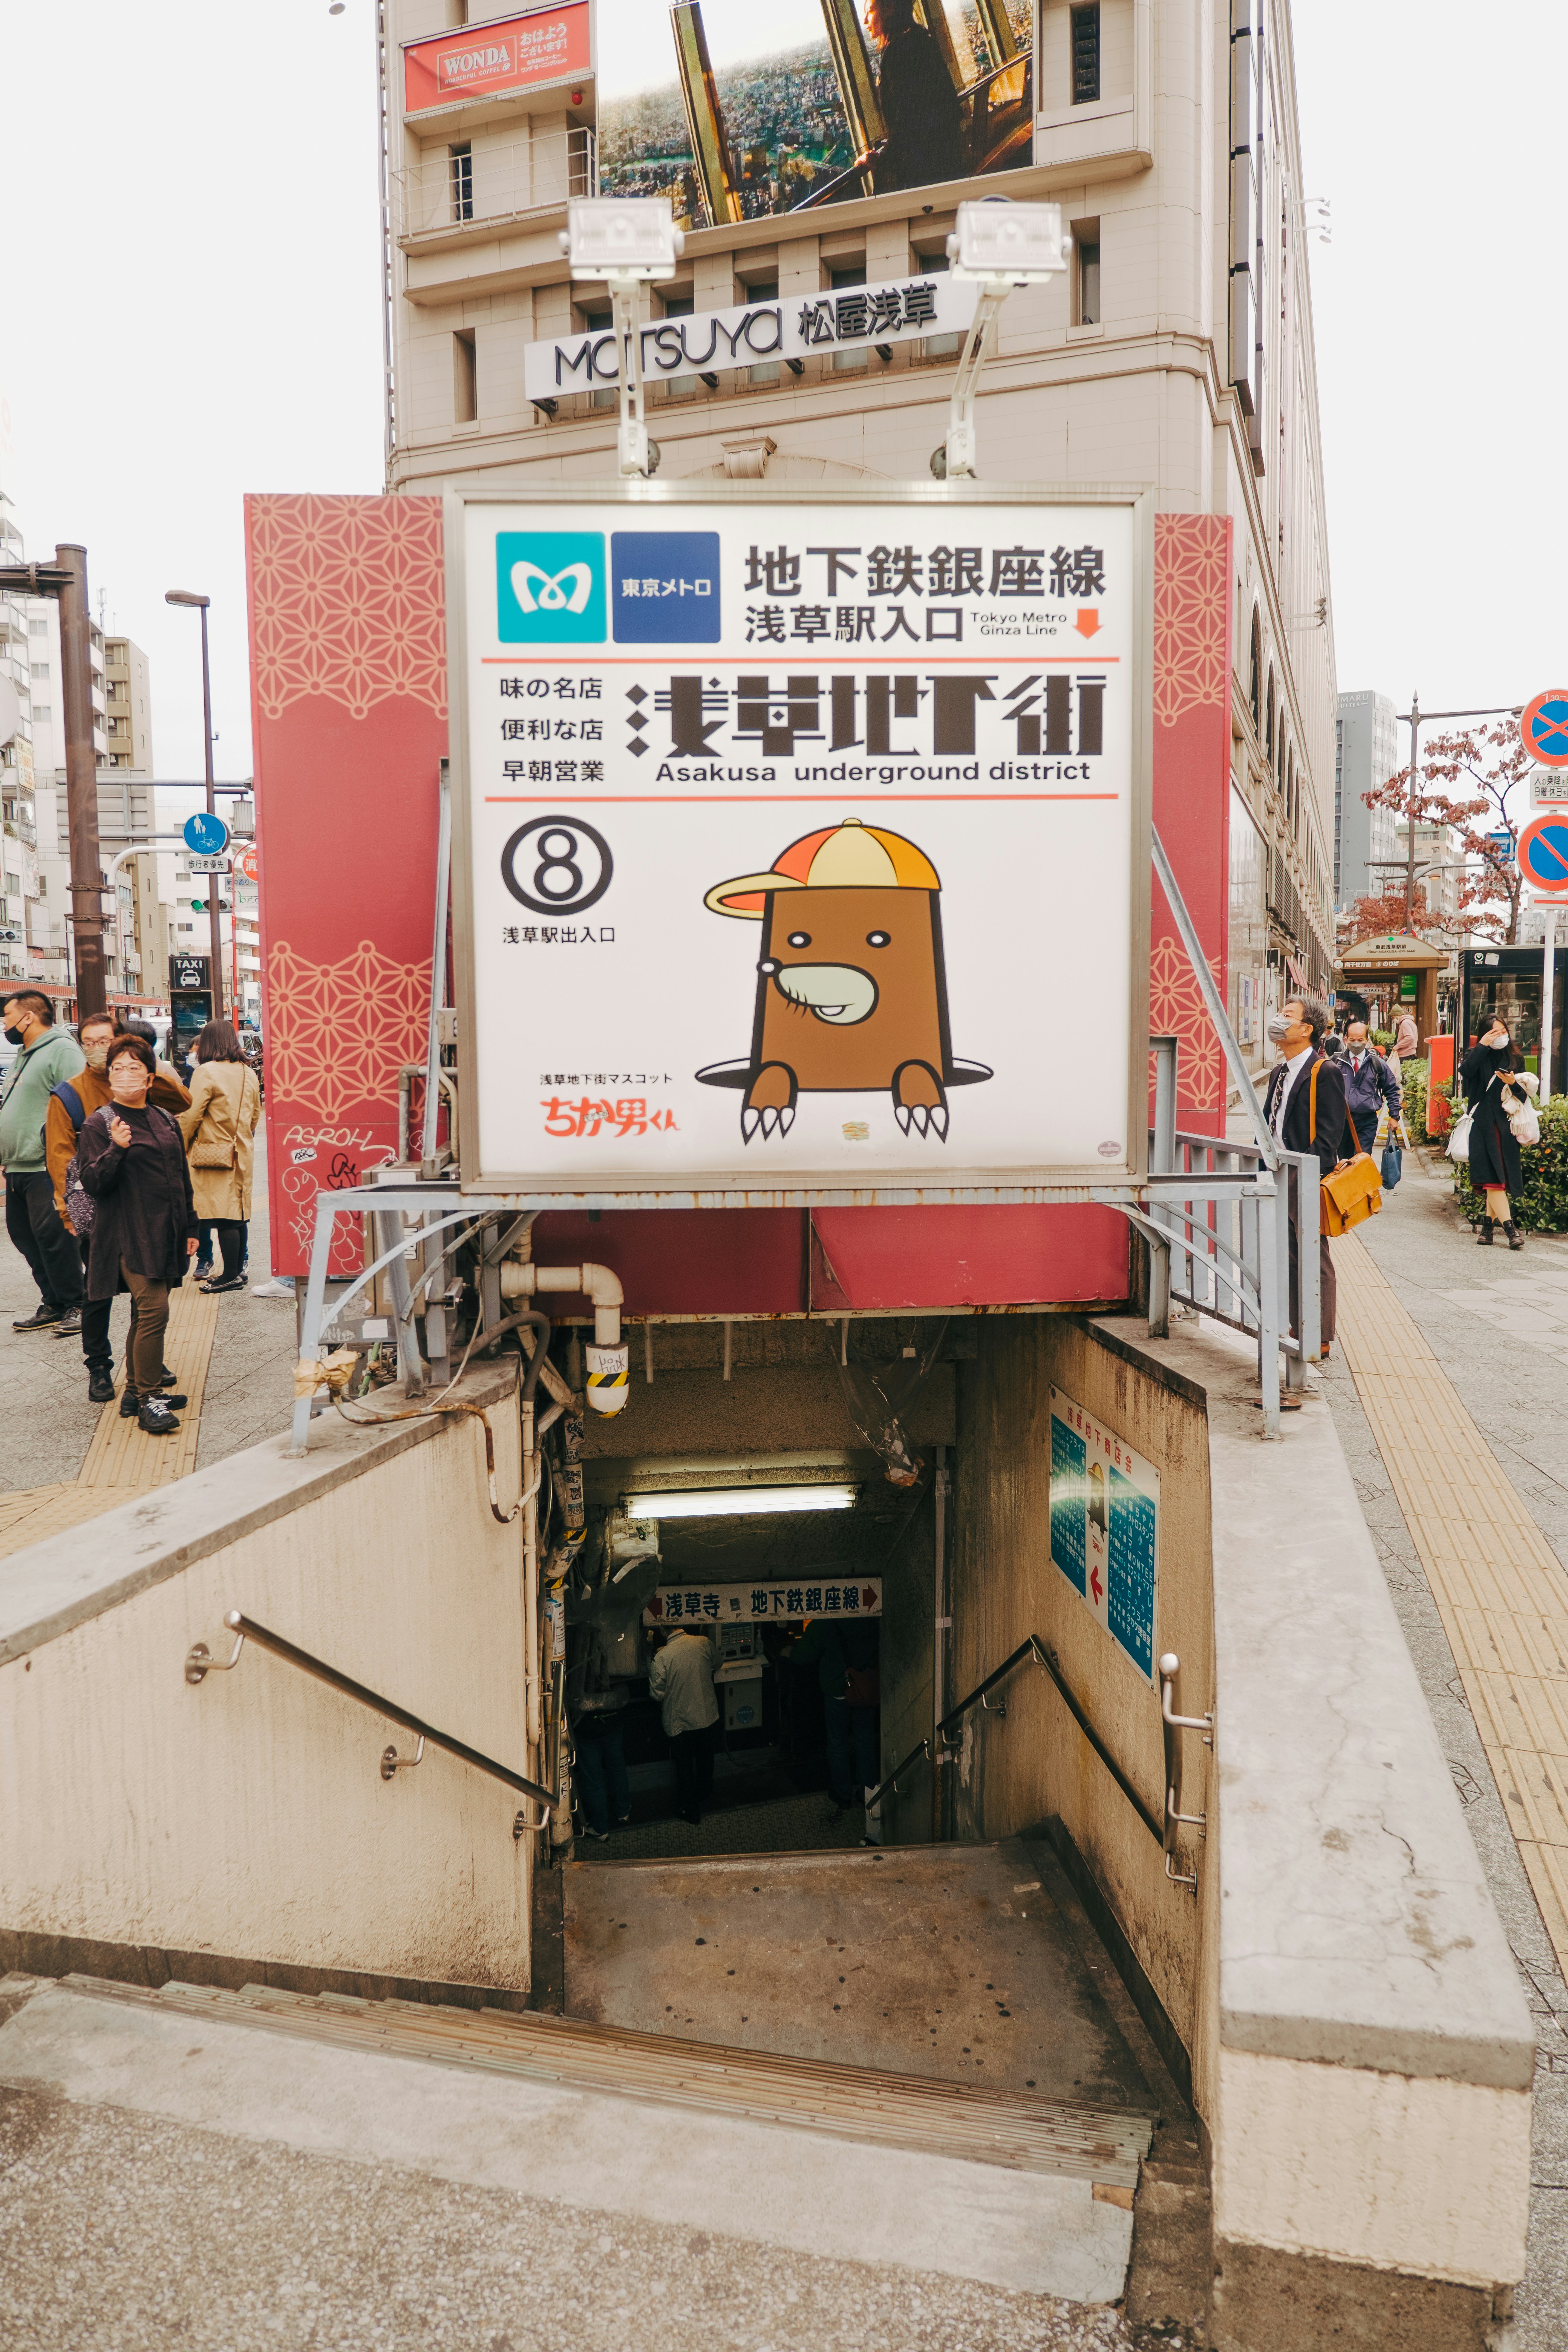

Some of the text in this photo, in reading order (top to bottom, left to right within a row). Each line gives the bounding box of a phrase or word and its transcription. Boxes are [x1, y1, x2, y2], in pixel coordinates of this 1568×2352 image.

[521, 23, 567, 45] おはよう
[444, 44, 510, 75] WONDA
[444, 66, 500, 84] WONDERFUL COFFEE
[798, 281, 938, 346] 松屋浅草
[744, 545, 1107, 598] 地下鉄銀座線
[622, 578, 711, 597] 東京メトロ
[746, 605, 962, 643] 浅草駅入口
[971, 613, 1066, 626] Tokyo Metro
[981, 626, 1057, 634] Ginza Line
[501, 678, 602, 698] 味の名店
[625, 675, 1106, 758] 浅草地下街
[501, 719, 602, 740] 便利な店
[503, 761, 603, 781] 早朝営業
[656, 762, 1089, 784] Asakusa underground district
[188, 860, 224, 869] 歩行者優先
[504, 927, 614, 943] 浅草駅出入口
[176, 960, 202, 968] TAXI
[541, 1074, 671, 1085] 浅草地下街マスコット
[540, 1096, 680, 1138] ちか男くん
[1066, 1431, 1085, 1456] Jプライス
[1068, 1406, 1132, 1474] 浅草地下商店会
[1129, 1499, 1153, 1531] 福ちゃん
[1110, 1508, 1153, 1558] ラーメン 山小屋
[1128, 1512, 1153, 1544] メトロスタンプ
[1128, 1549, 1152, 1584] MONTEE
[666, 1586, 859, 1617] 浅草寺 地下鉄銀座線
